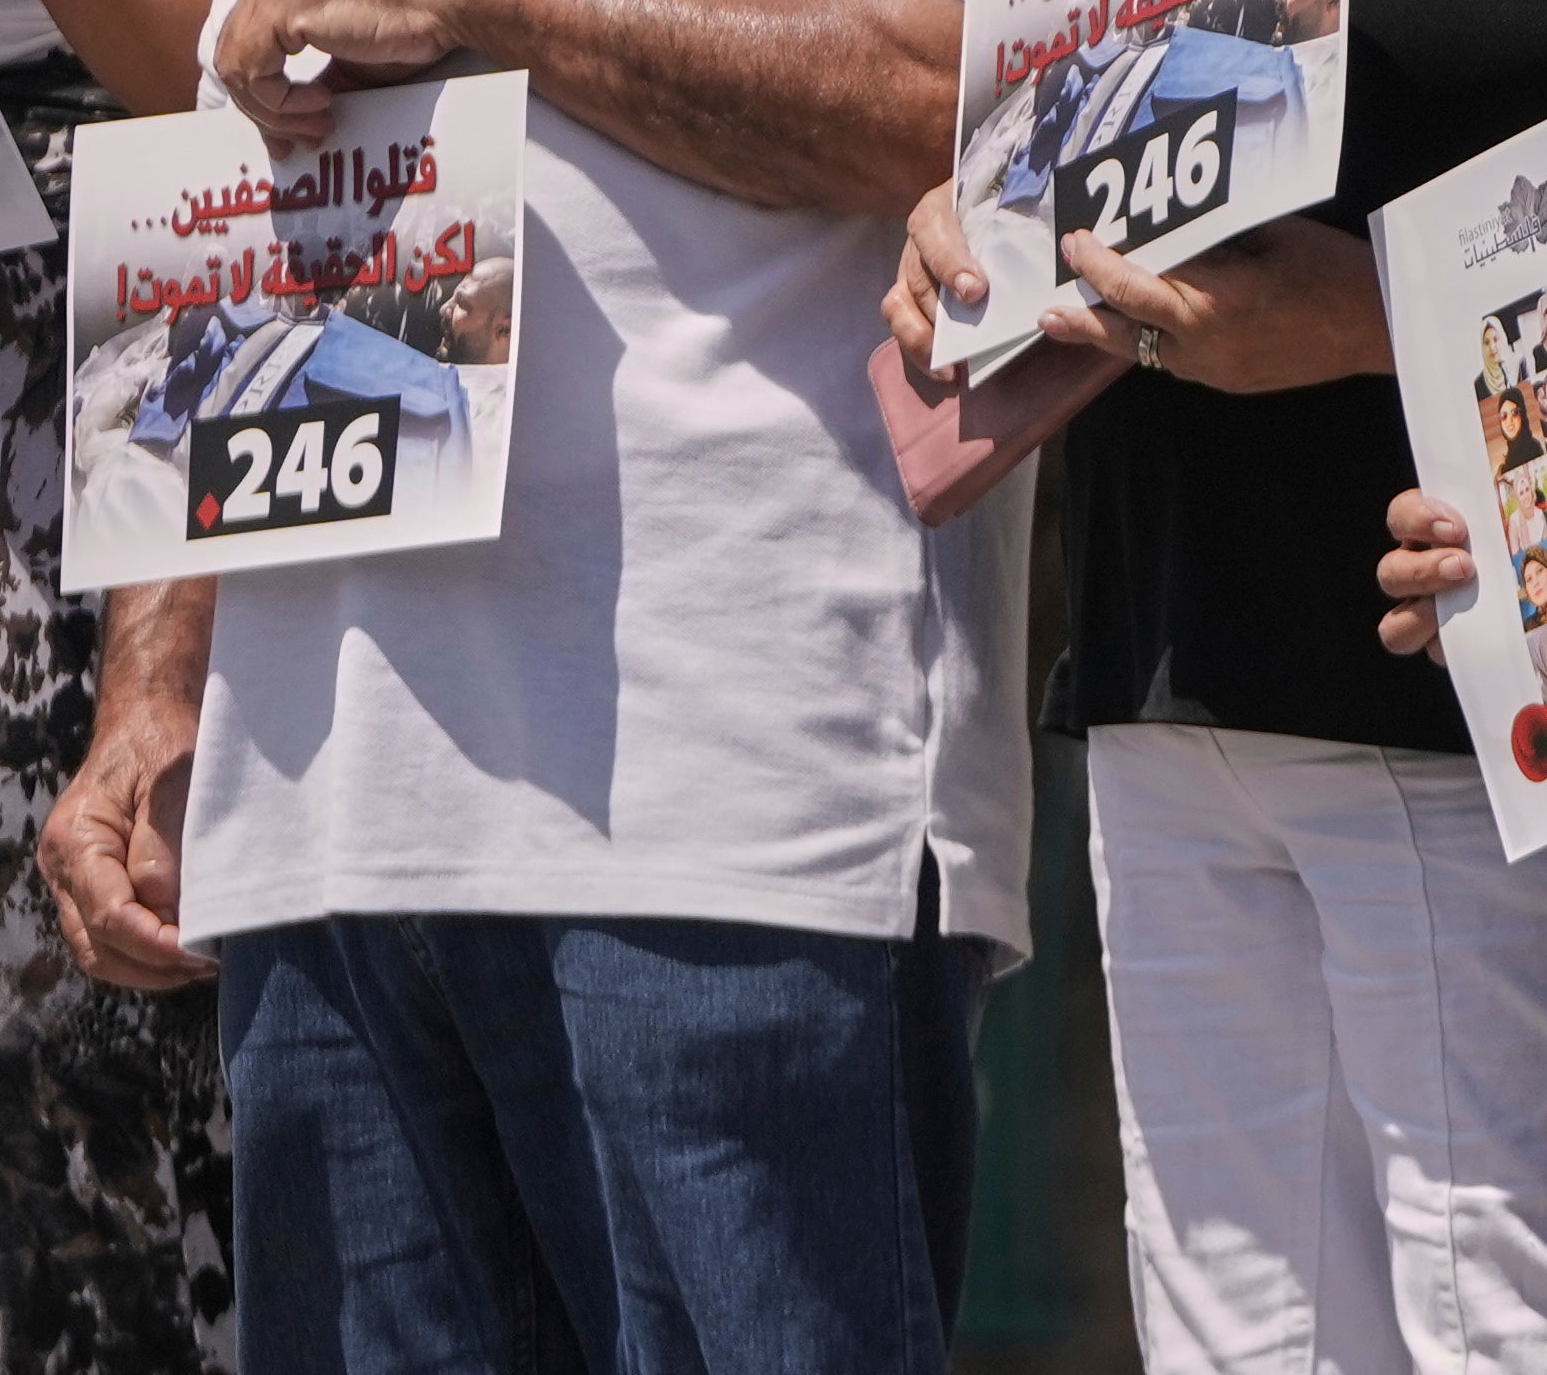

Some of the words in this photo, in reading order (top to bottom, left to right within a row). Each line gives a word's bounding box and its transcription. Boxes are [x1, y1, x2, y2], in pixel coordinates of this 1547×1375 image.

[994, 6, 1080, 98] تموت!
[353, 135, 437, 217] قتلوا
[1085, 110, 1220, 248] 246
[117, 255, 222, 326] تموت!
[229, 246, 255, 304] لا
[261, 231, 397, 307] الحقيقة
[405, 220, 476, 293] لكن
[222, 412, 383, 523] 246
